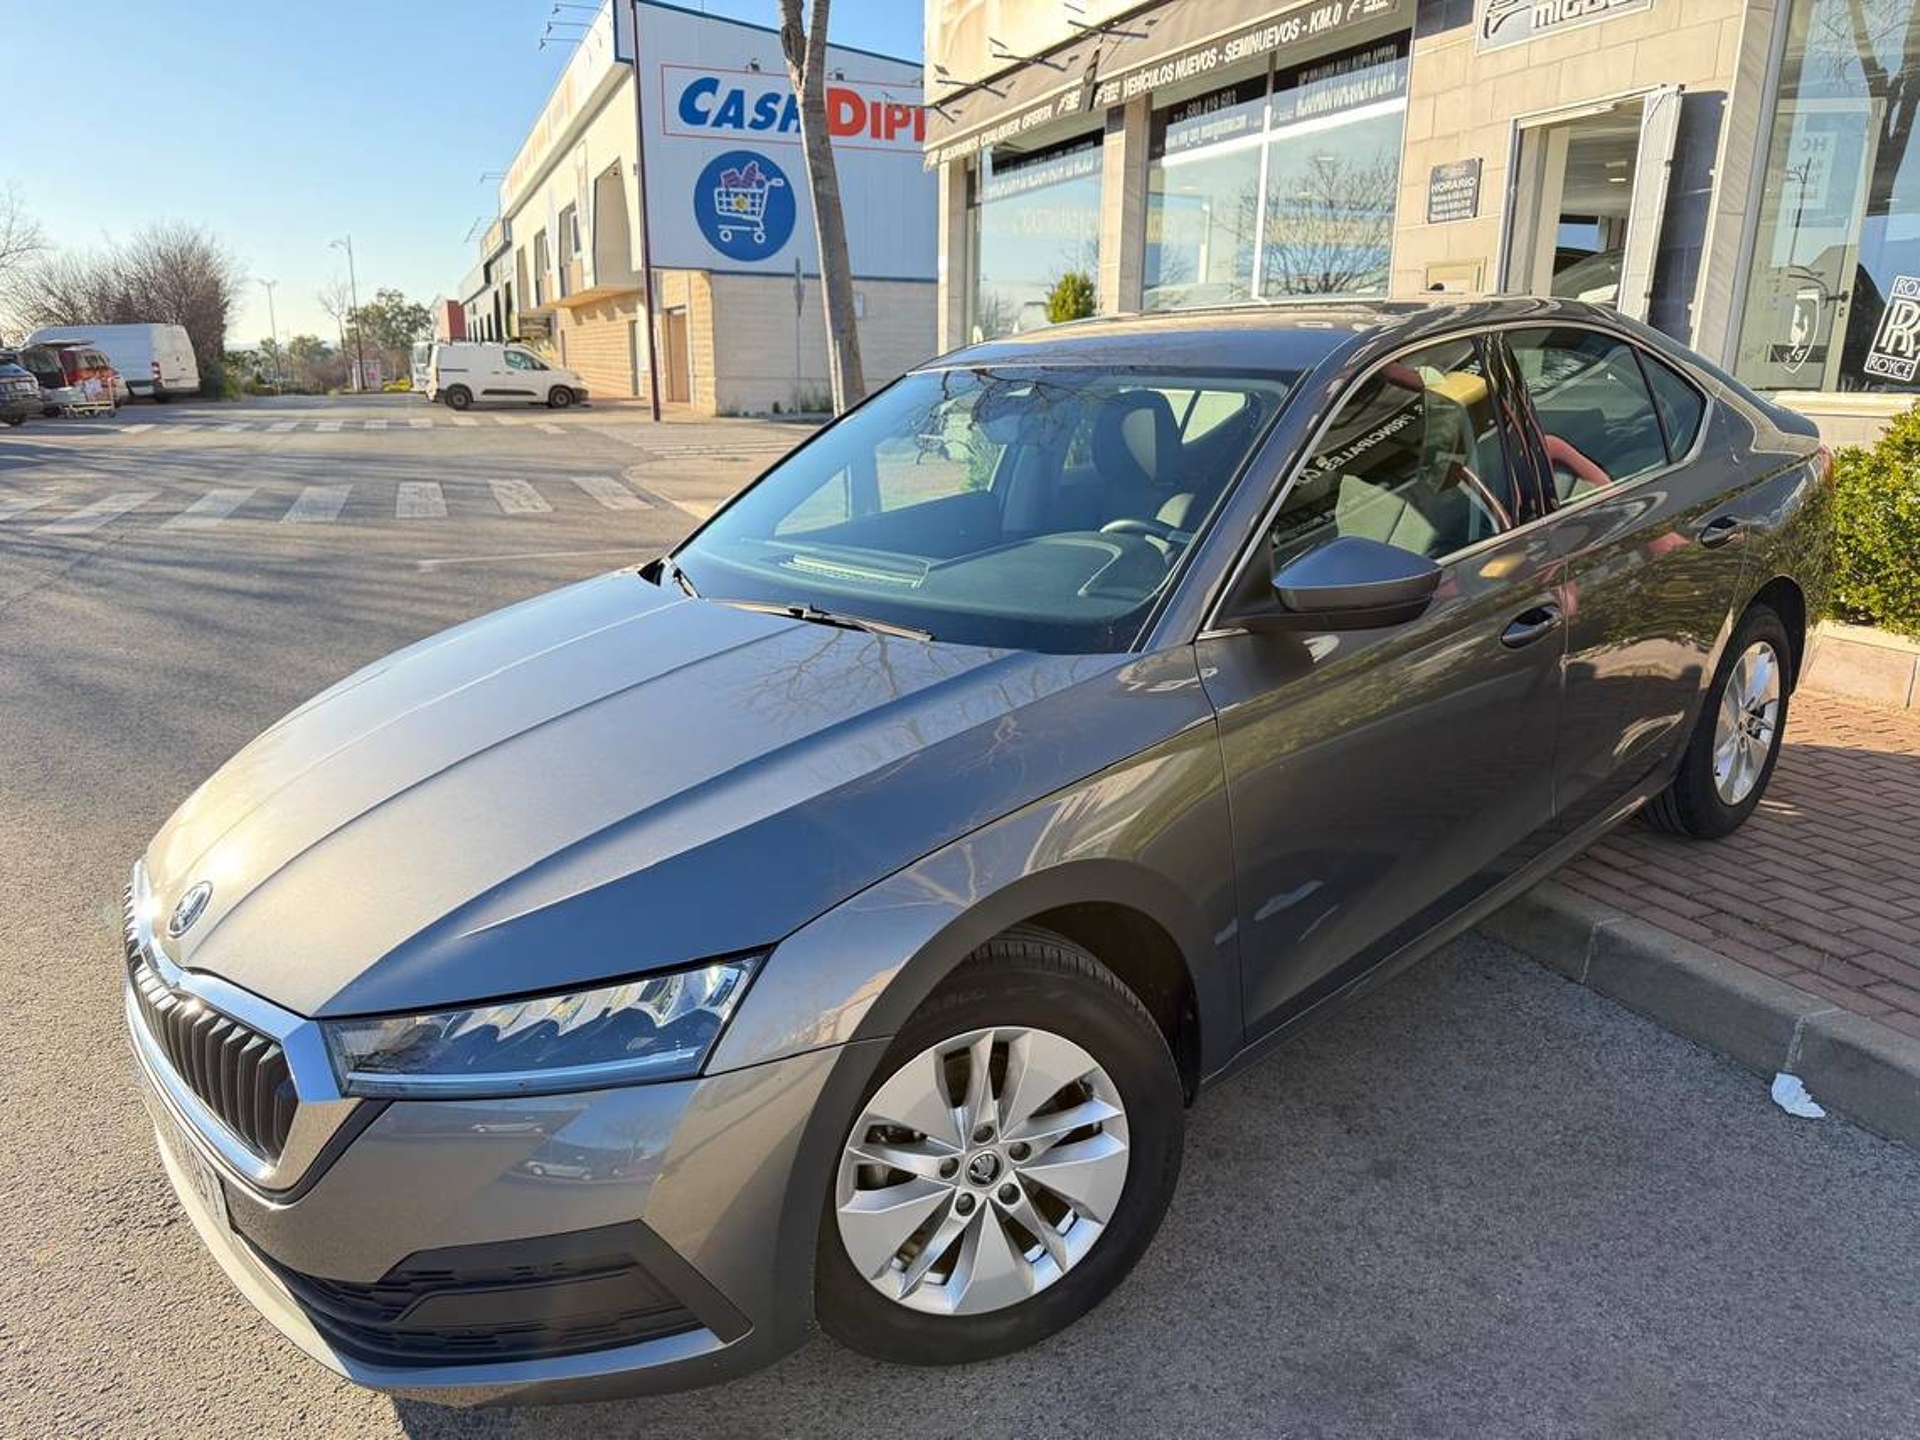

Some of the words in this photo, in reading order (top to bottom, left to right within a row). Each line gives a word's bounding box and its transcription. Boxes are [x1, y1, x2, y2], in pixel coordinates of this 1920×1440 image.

[1123, 62, 1174, 98] VEHÍCULOS
[1175, 47, 1218, 81] NUEVOS
[1224, 18, 1301, 63] SEMINUEVOS
[1308, 3, 1343, 34] KM.0
[1869, 356, 1912, 377] ROYCE
